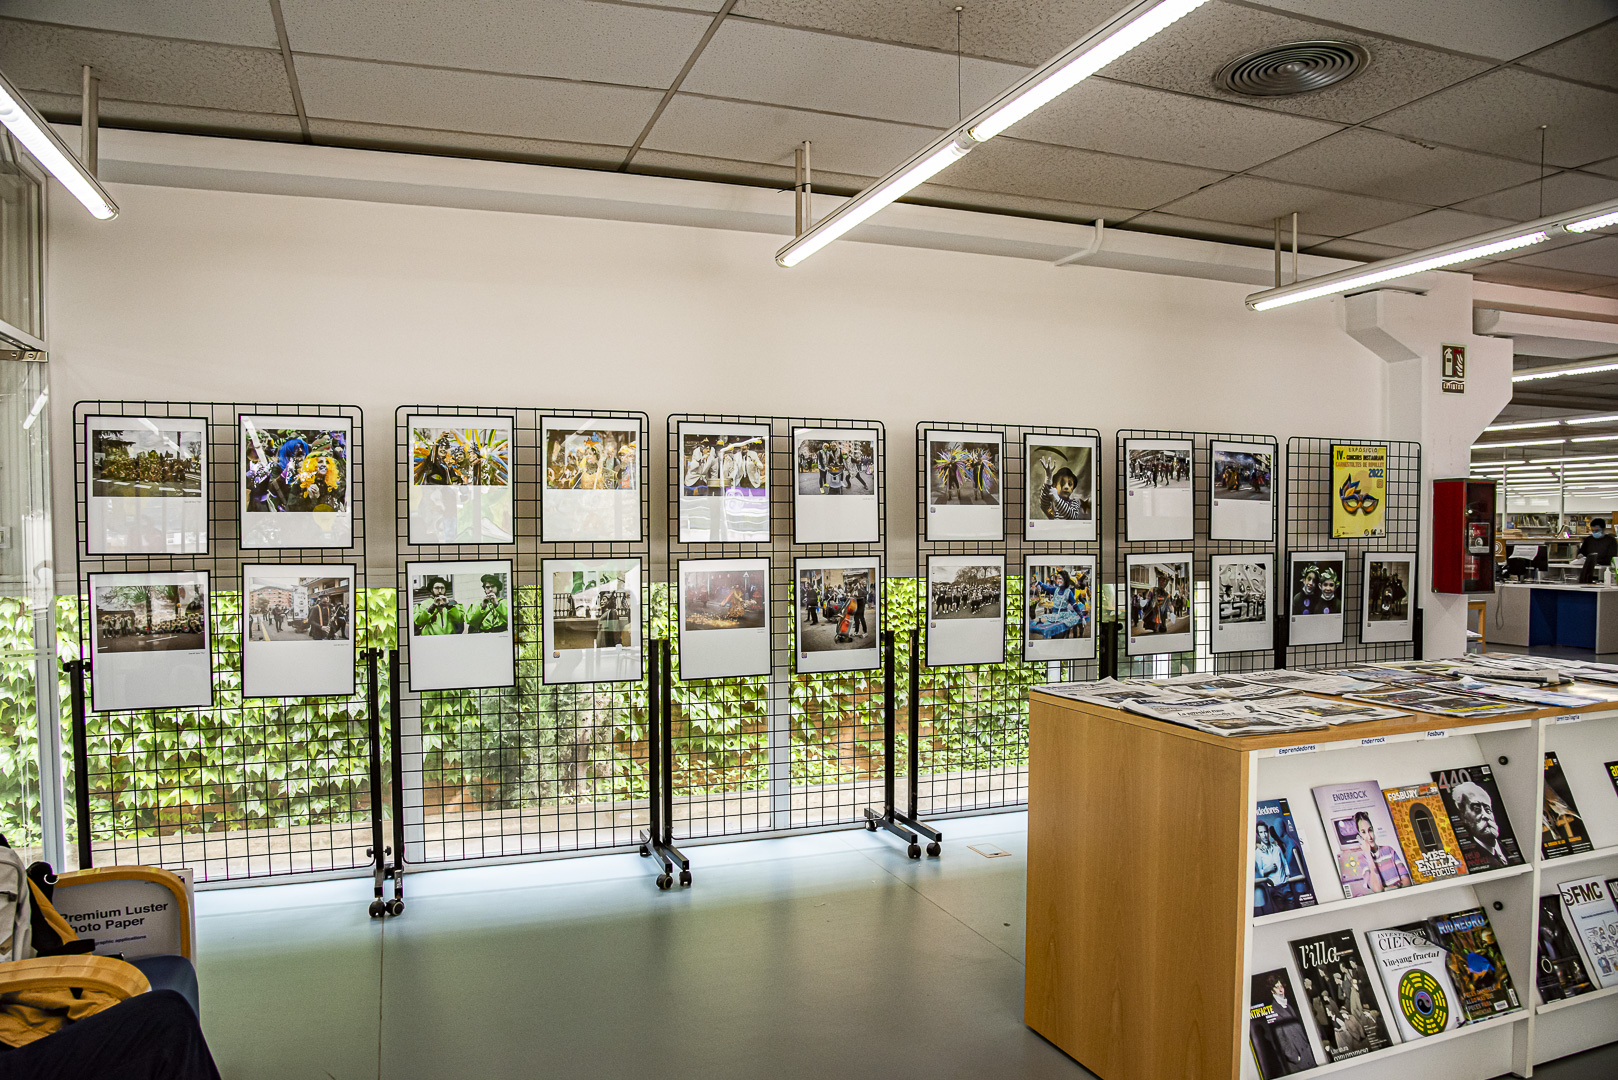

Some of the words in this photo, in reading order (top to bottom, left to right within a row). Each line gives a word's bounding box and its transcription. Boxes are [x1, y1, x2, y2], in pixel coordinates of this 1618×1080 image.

[1368, 468, 1384, 478] 2022
[1427, 730, 1445, 738] Fosbury
[1361, 737, 1386, 745] Enderrock
[1278, 745, 1316, 755] Emprendedores
[1332, 790, 1368, 802] ENDERROCK
[1387, 789, 1418, 801] FOSBURY
[1257, 806, 1280, 816] dedores
[1431, 867, 1456, 878] FOCUS
[60, 907, 121, 923] Premium
[125, 902, 169, 916] Luster
[70, 923, 101, 934] hoto
[105, 916, 146, 930] Paper
[1452, 914, 1485, 931] NEGRO
[95, 938, 114, 947] graphic
[115, 935, 147, 944] applications
[1382, 955, 1412, 967] Yin-yang
[1412, 950, 1440, 961] fractal
